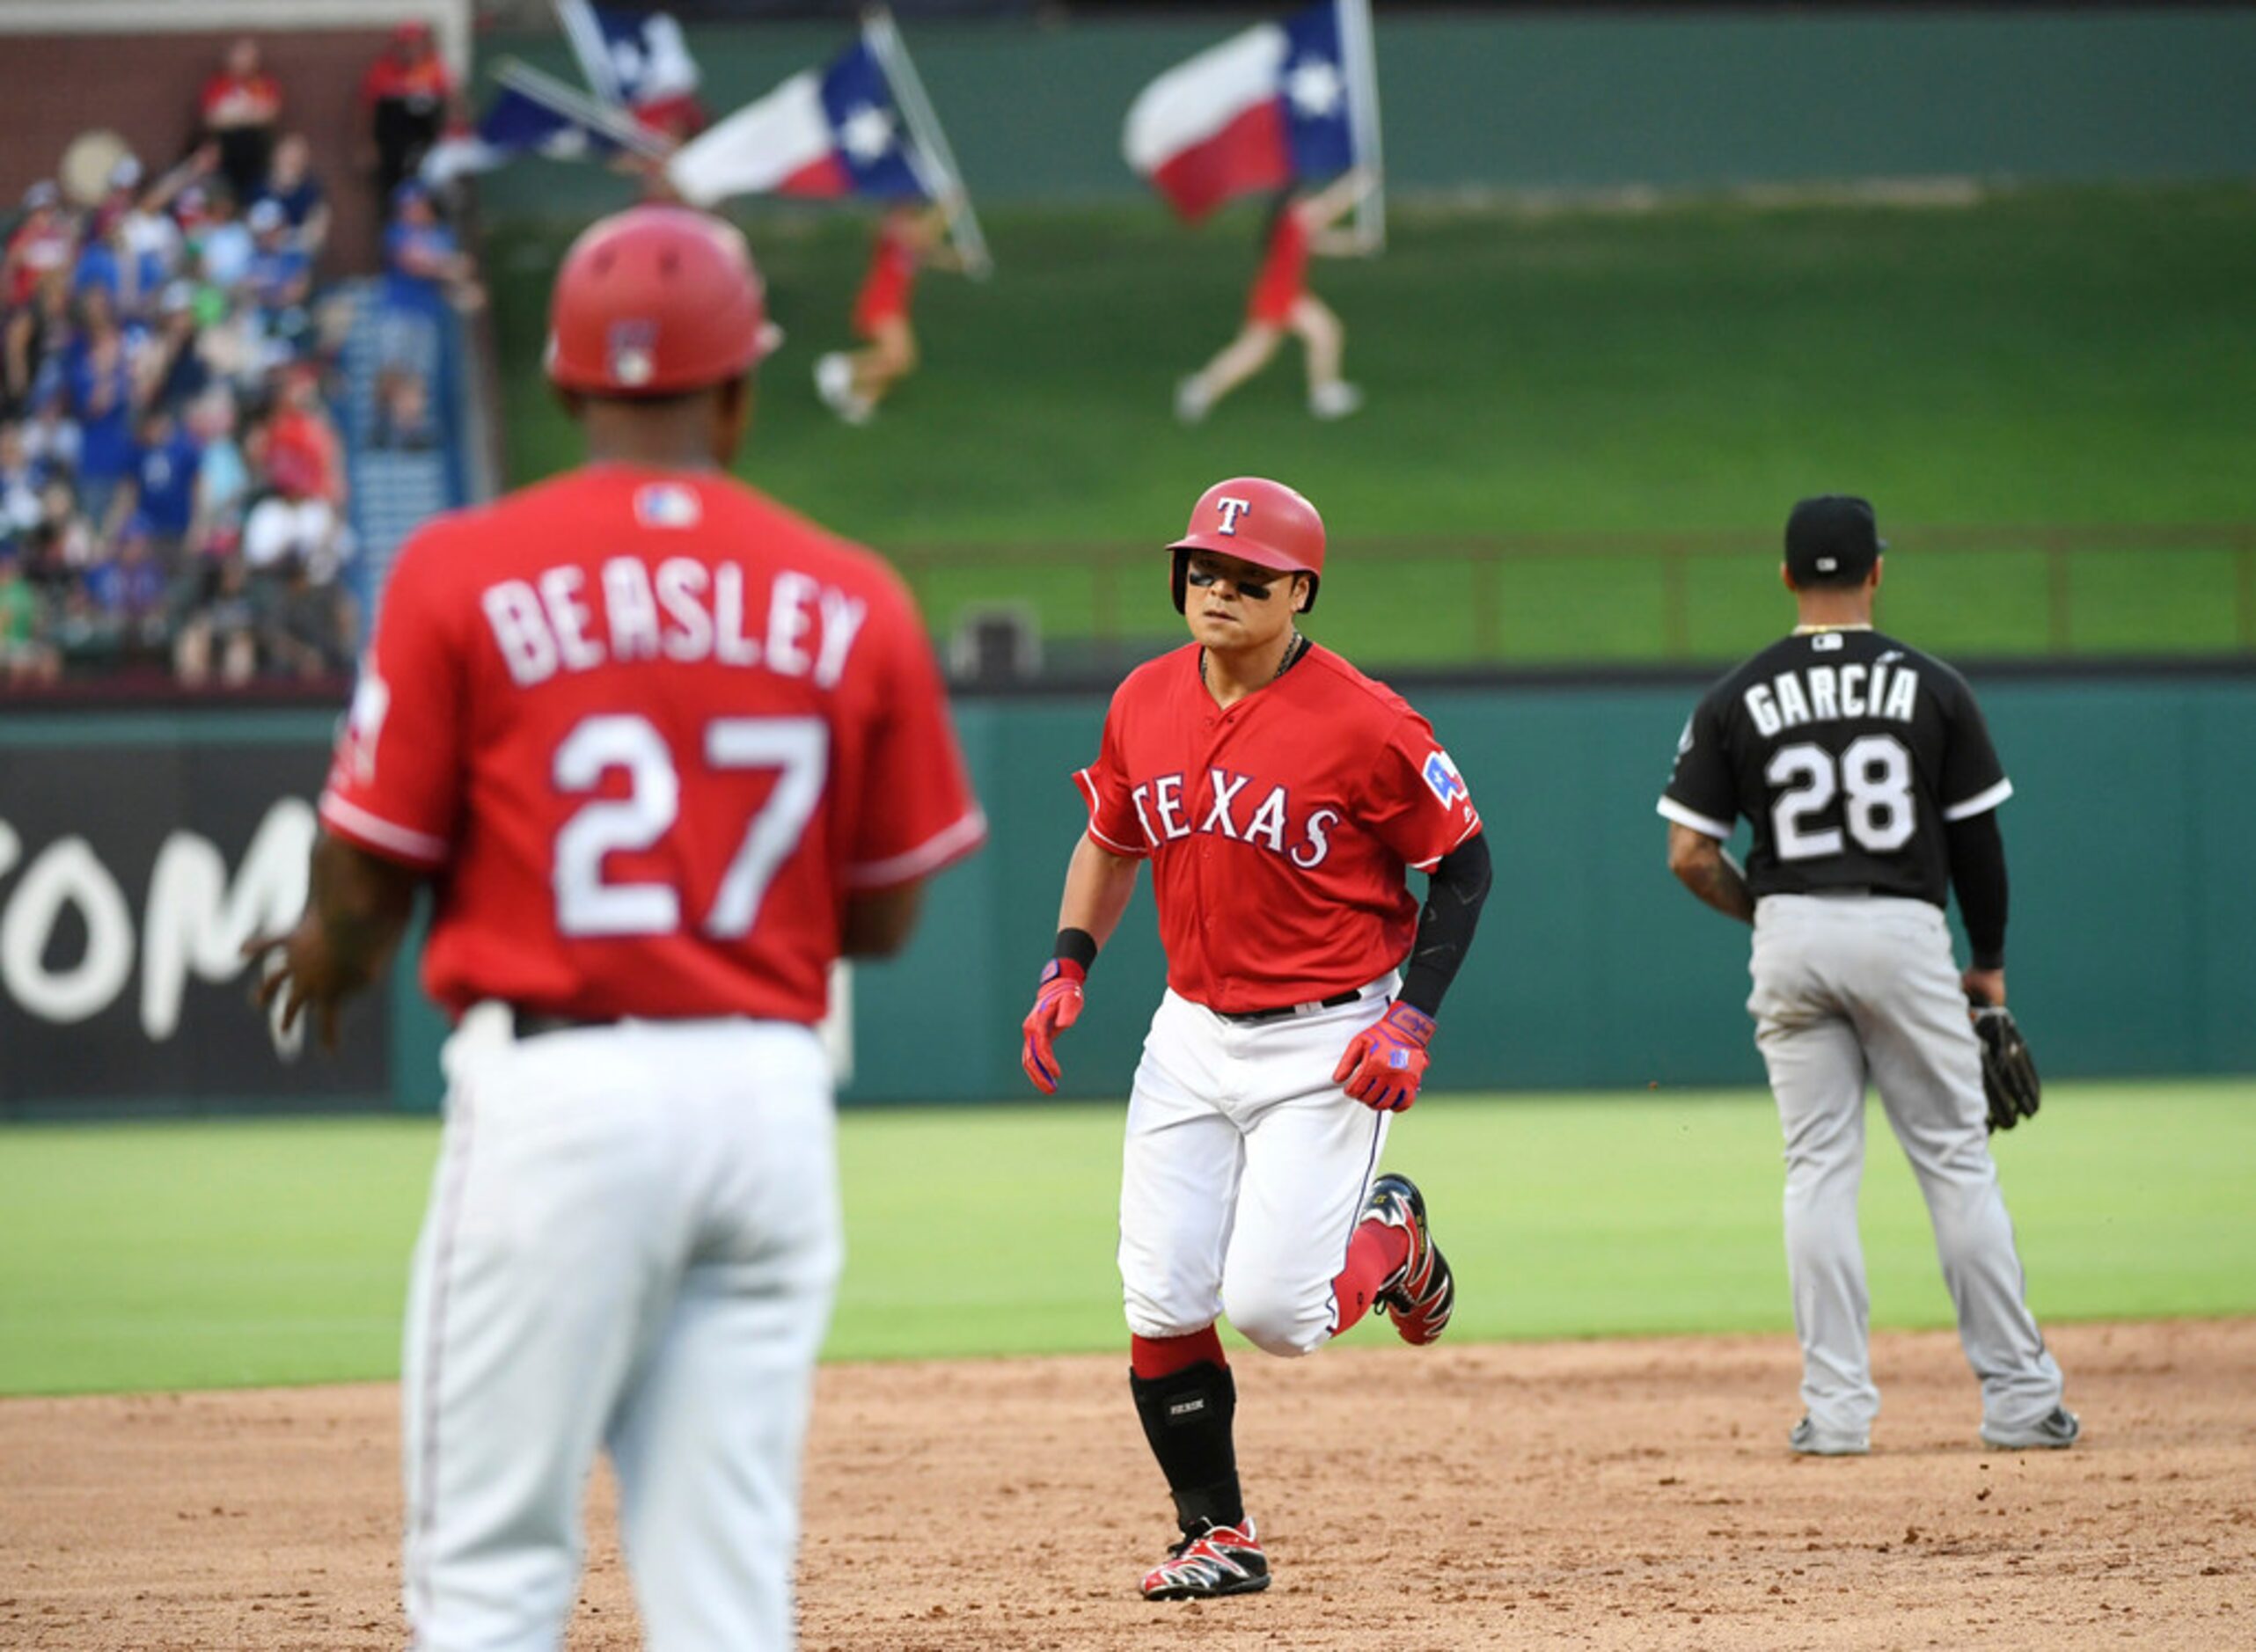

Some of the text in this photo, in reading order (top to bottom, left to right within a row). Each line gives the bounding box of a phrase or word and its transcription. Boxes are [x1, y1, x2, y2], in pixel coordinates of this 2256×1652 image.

[1217, 496, 1251, 536] T
[480, 555, 868, 689] BEASLEY
[1743, 650, 1920, 738] GARCÍA
[552, 713, 830, 940] 27
[1131, 766, 1340, 869] TEXAS
[1764, 734, 1918, 861] 28
